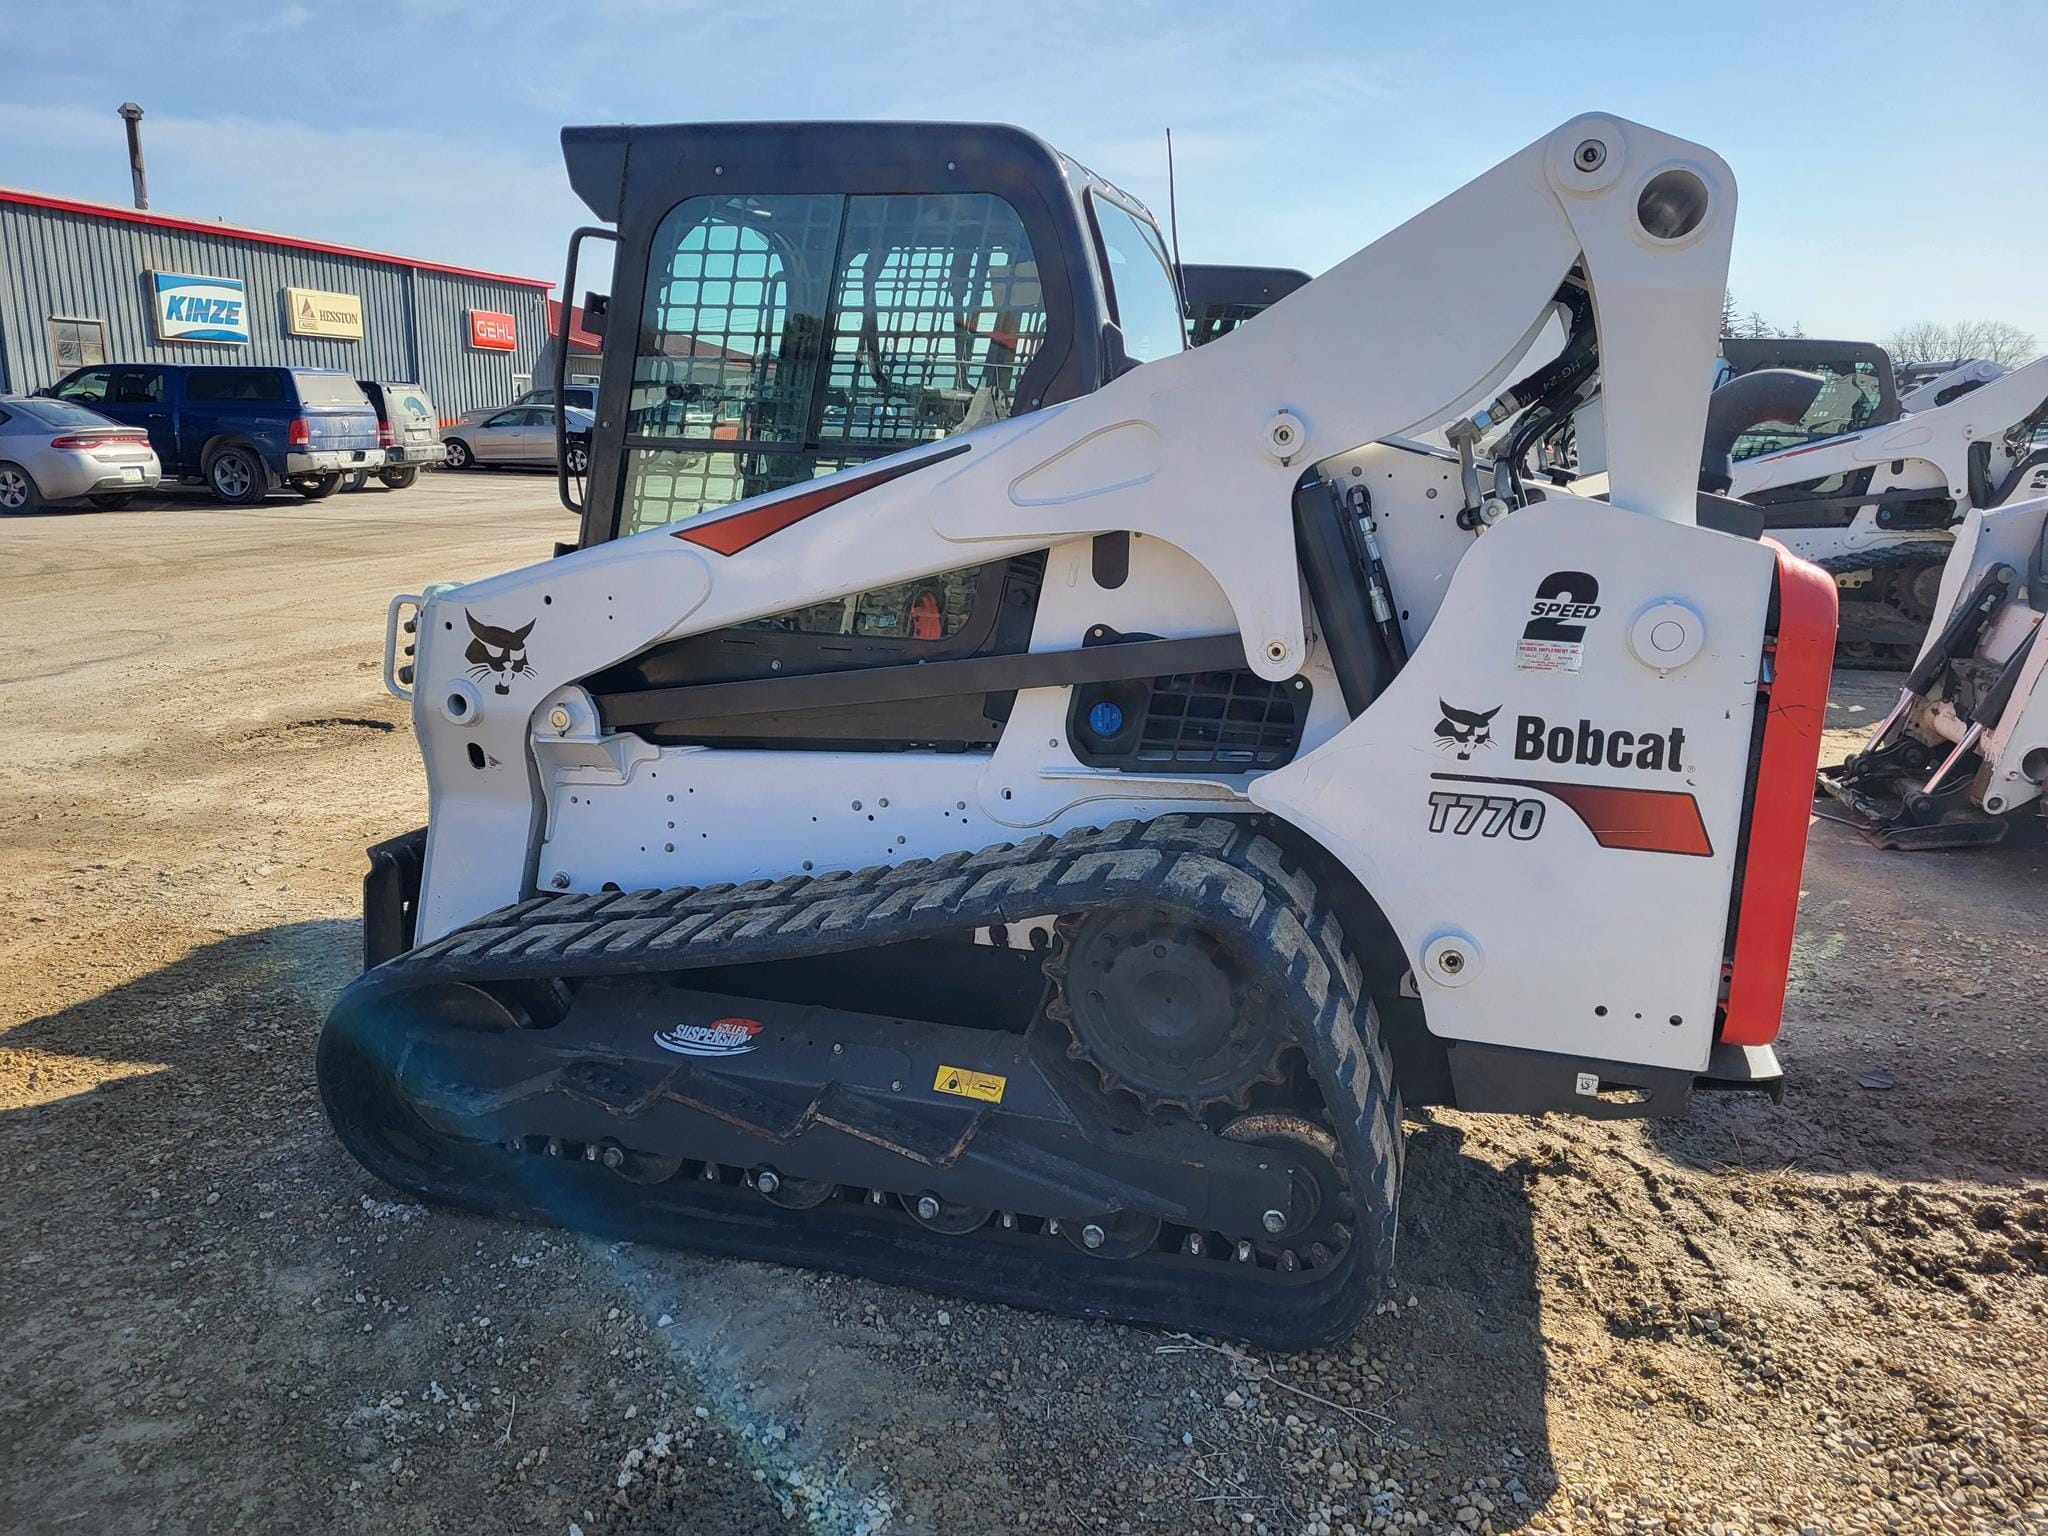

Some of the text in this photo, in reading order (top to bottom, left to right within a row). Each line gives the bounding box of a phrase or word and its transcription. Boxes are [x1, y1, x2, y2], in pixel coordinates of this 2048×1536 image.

[165, 295, 242, 326] KINZE
[319, 310, 358, 325] HESSTON
[476, 320, 515, 340] GEHL
[1522, 571, 1599, 643] 2
[1530, 602, 1602, 619] SPEED
[1514, 715, 1686, 773] Bobcat
[1428, 791, 1546, 841] T770
[673, 1023, 753, 1047] SUSPENSION
